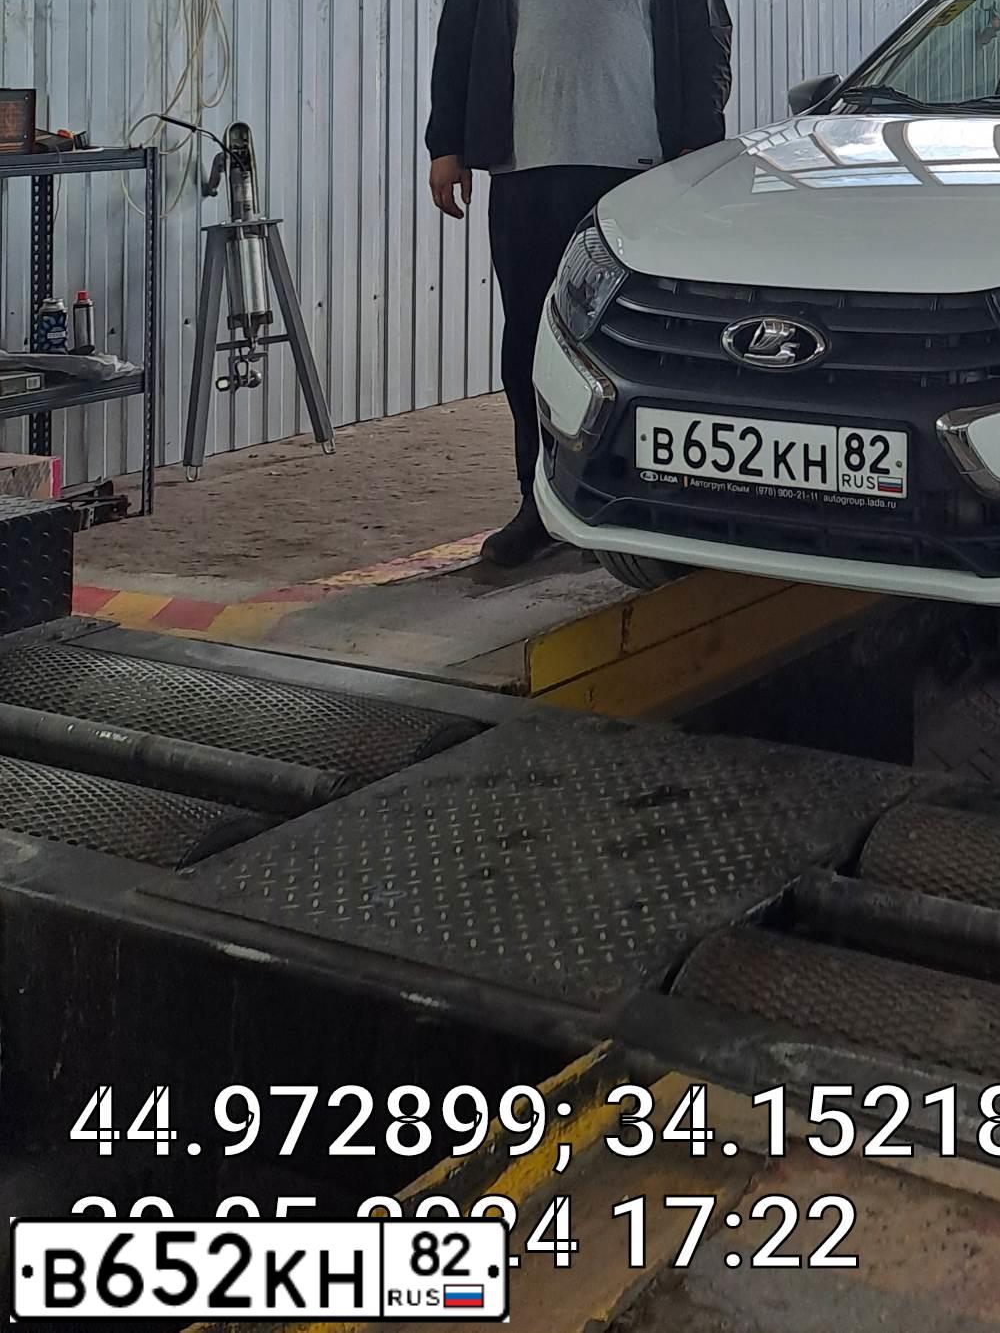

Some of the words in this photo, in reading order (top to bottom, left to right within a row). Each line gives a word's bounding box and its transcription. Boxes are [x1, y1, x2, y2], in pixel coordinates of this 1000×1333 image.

[843, 433, 890, 475] 82
[659, 475, 679, 484] LADA
[842, 473, 876, 490] RUS
